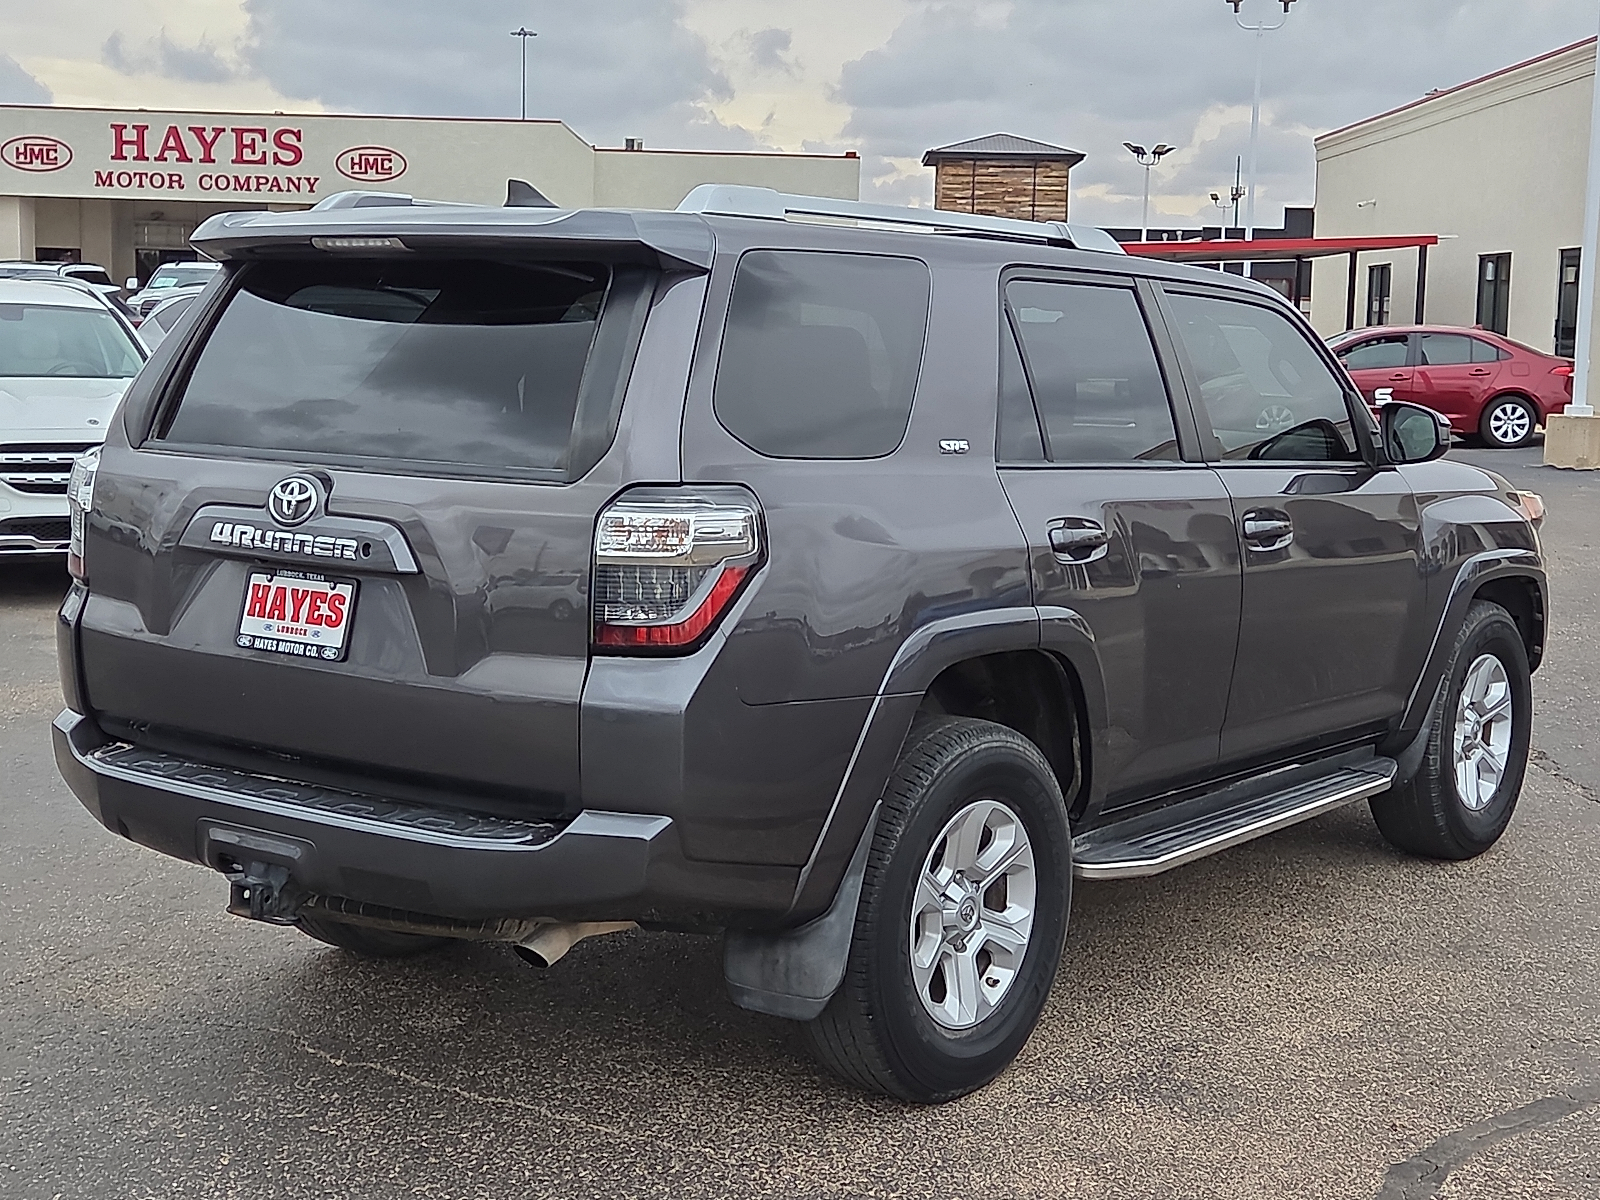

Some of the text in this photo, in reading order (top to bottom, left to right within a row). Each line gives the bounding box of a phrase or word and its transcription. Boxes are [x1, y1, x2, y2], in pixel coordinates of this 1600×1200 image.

[15, 142, 58, 165] HMC
[110, 123, 303, 166] HAYES
[350, 153, 393, 175] HMC
[94, 171, 320, 193] MOTOR COMPANY
[210, 521, 358, 561] 4RUNNER
[306, 572, 325, 582] TEXAS
[246, 583, 347, 628] HAYES
[276, 624, 308, 637] LUBBOCK
[253, 637, 278, 652] HAYES
[277, 641, 305, 656] MOTOR
[305, 645, 319, 658] CO.
